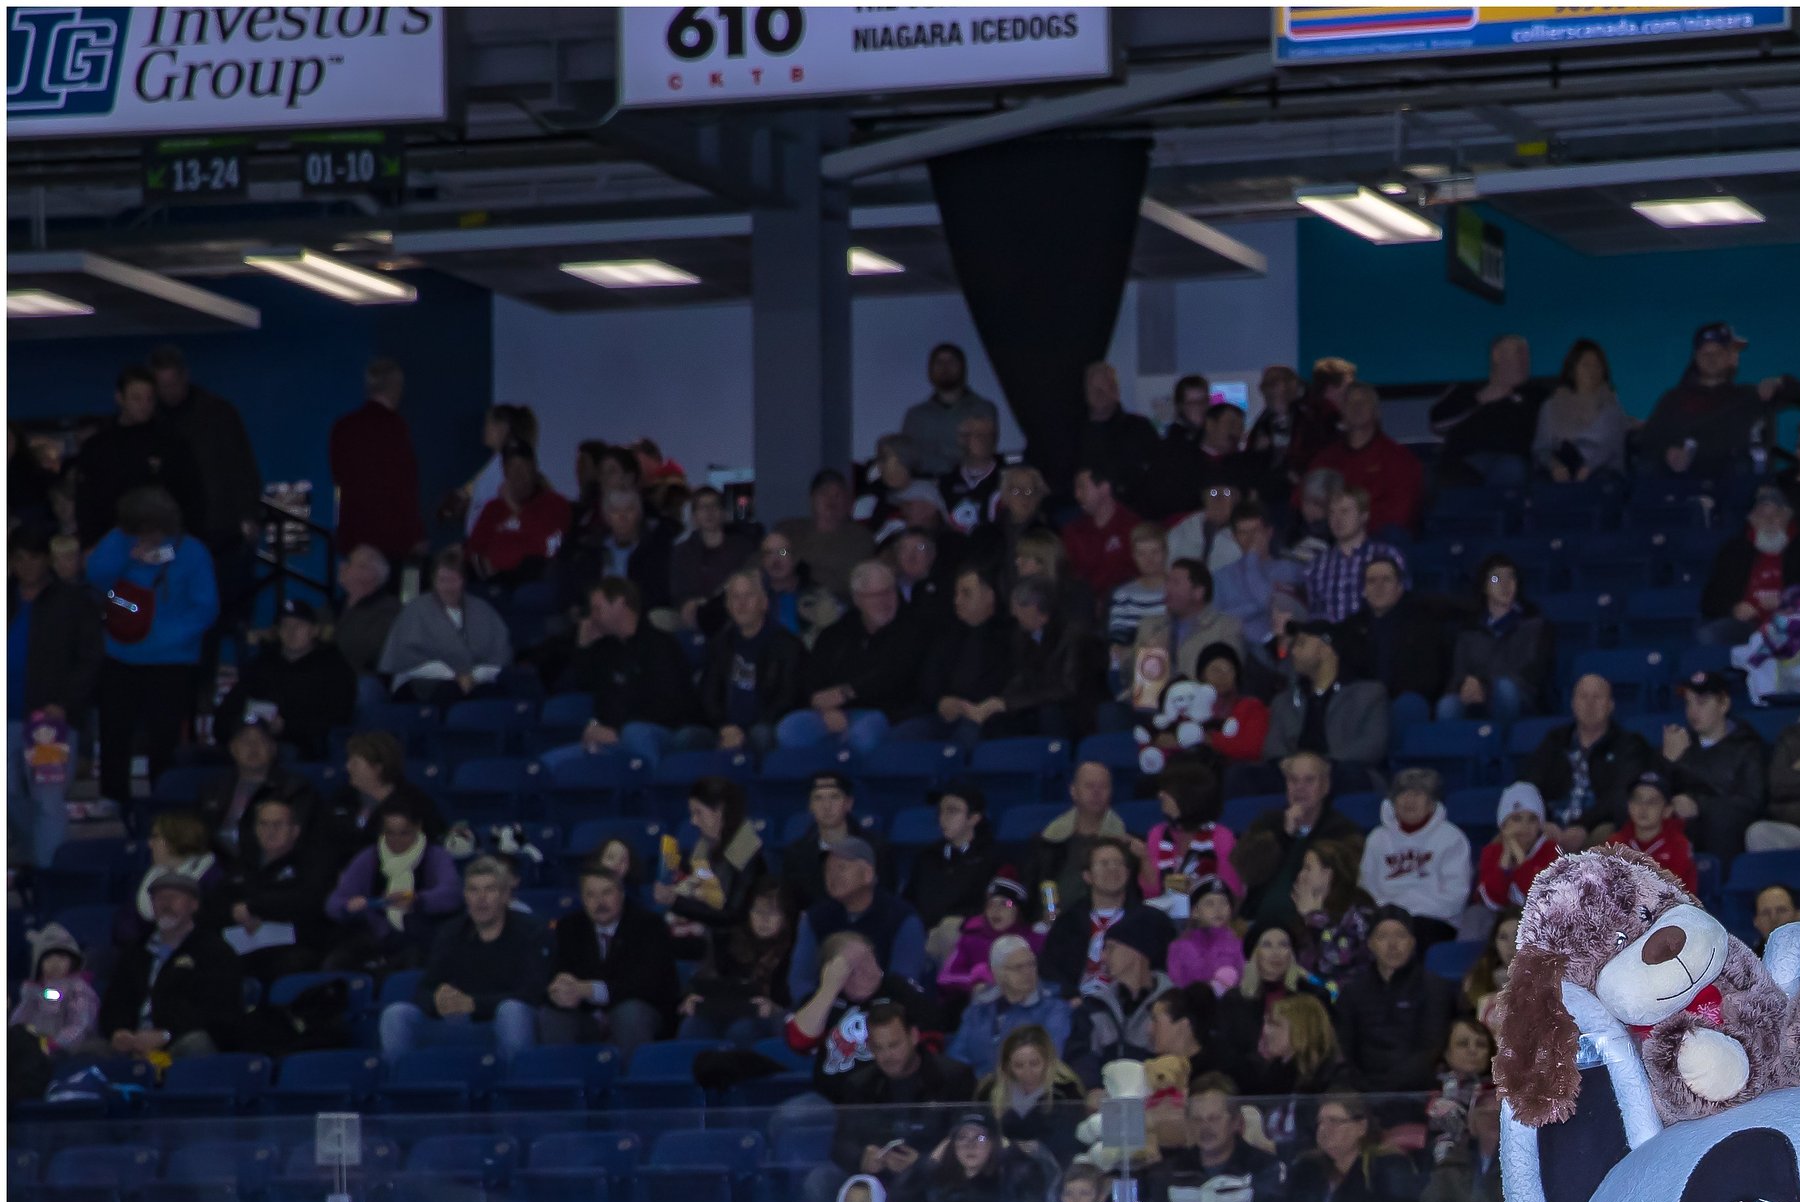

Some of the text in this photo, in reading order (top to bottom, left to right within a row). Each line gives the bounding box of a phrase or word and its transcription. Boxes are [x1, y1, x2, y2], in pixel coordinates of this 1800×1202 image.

[142, 7, 433, 47] Investors
[667, 7, 807, 60] 610
[852, 13, 1080, 52] NIAGARA ICEDOGS
[172, 157, 240, 192] 13-24
[305, 150, 376, 184] 01-10
